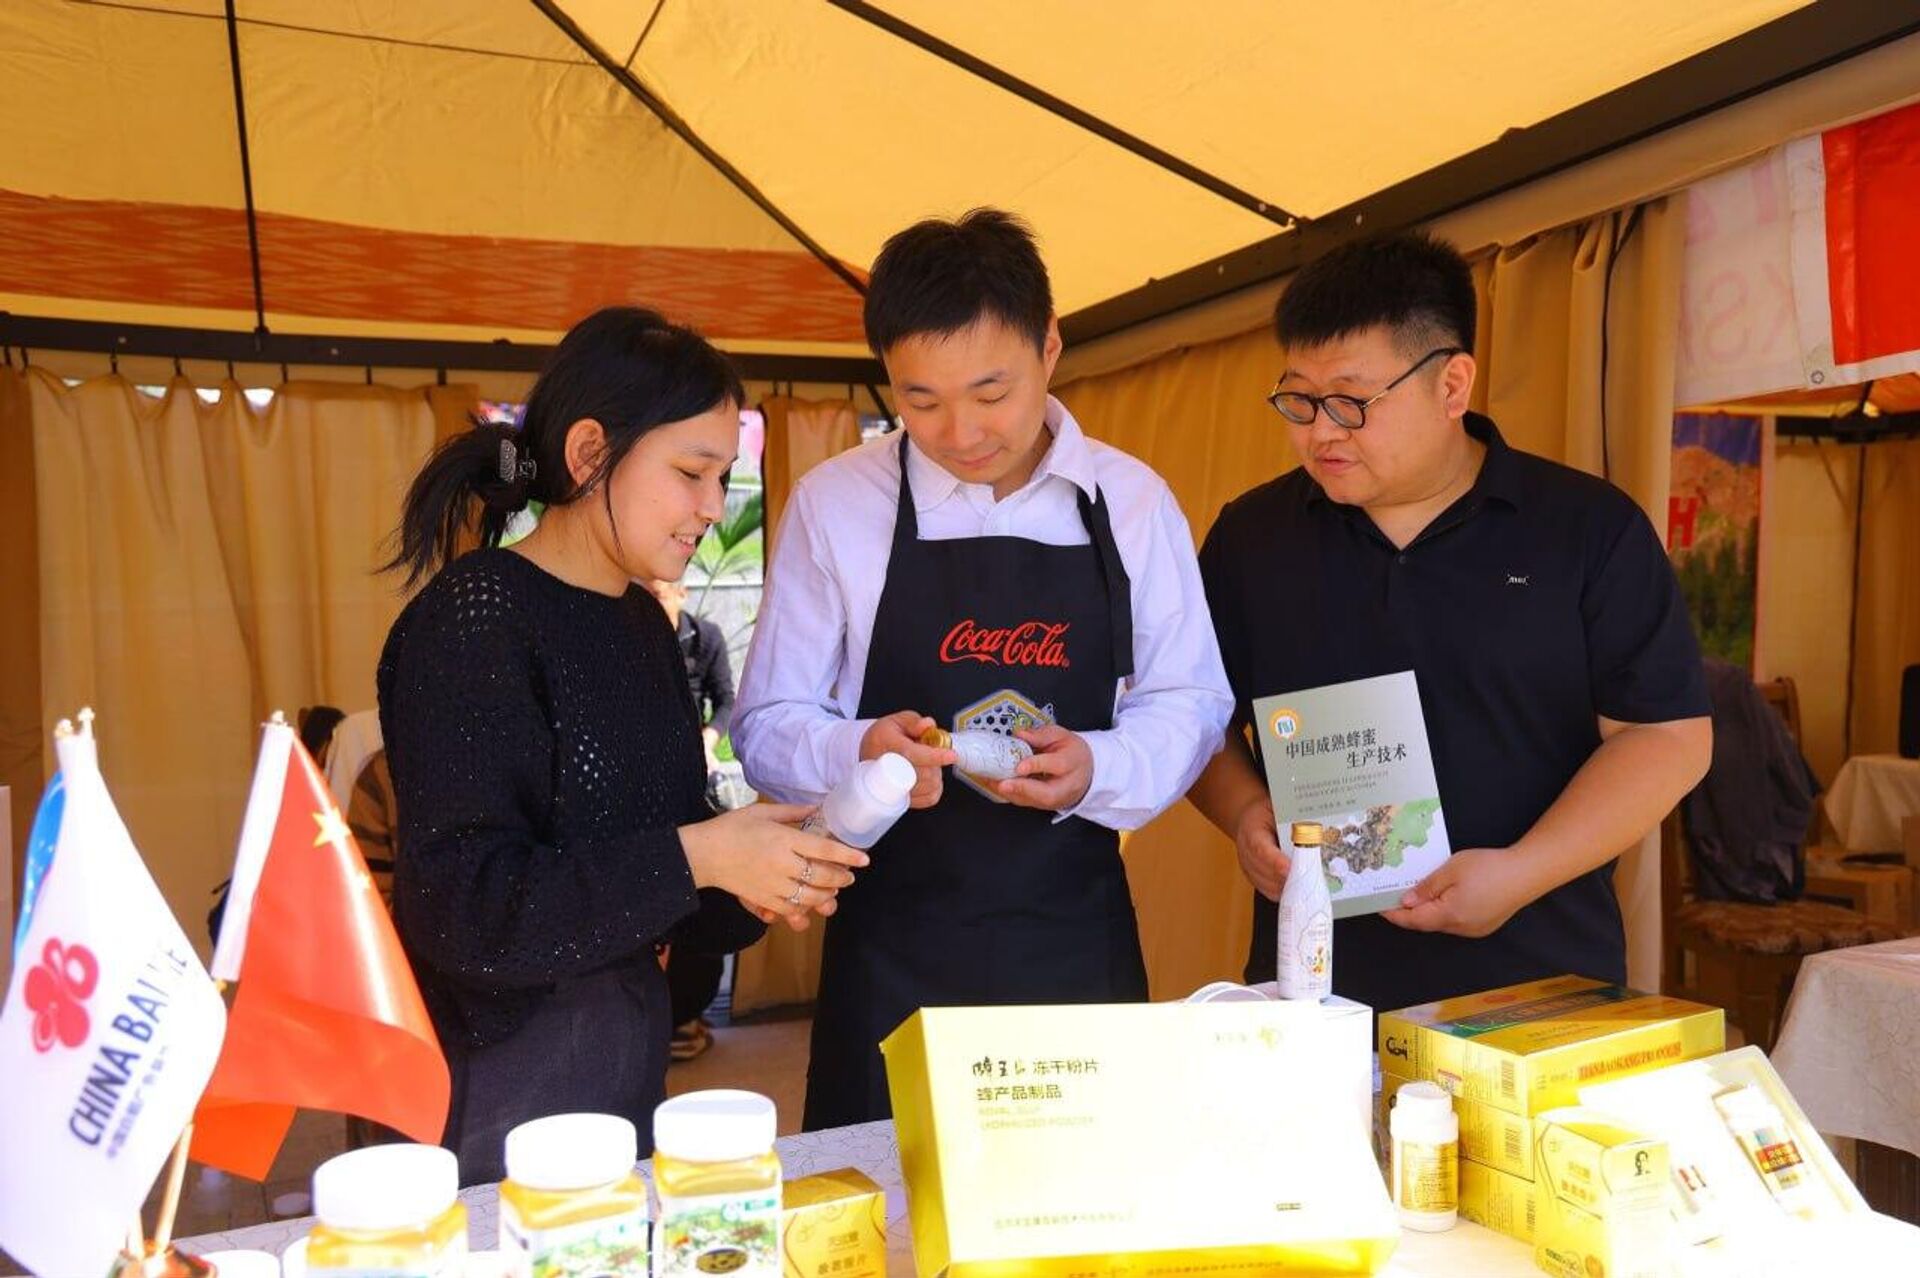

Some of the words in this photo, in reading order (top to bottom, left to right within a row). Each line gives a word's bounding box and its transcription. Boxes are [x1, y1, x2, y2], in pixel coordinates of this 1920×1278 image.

[939, 620, 1069, 667] Coca-Cola
[1286, 728, 1377, 759] 中国成熟蜂蜜
[1346, 743, 1407, 769] 生产技术
[69, 1046, 141, 1146] CHINA
